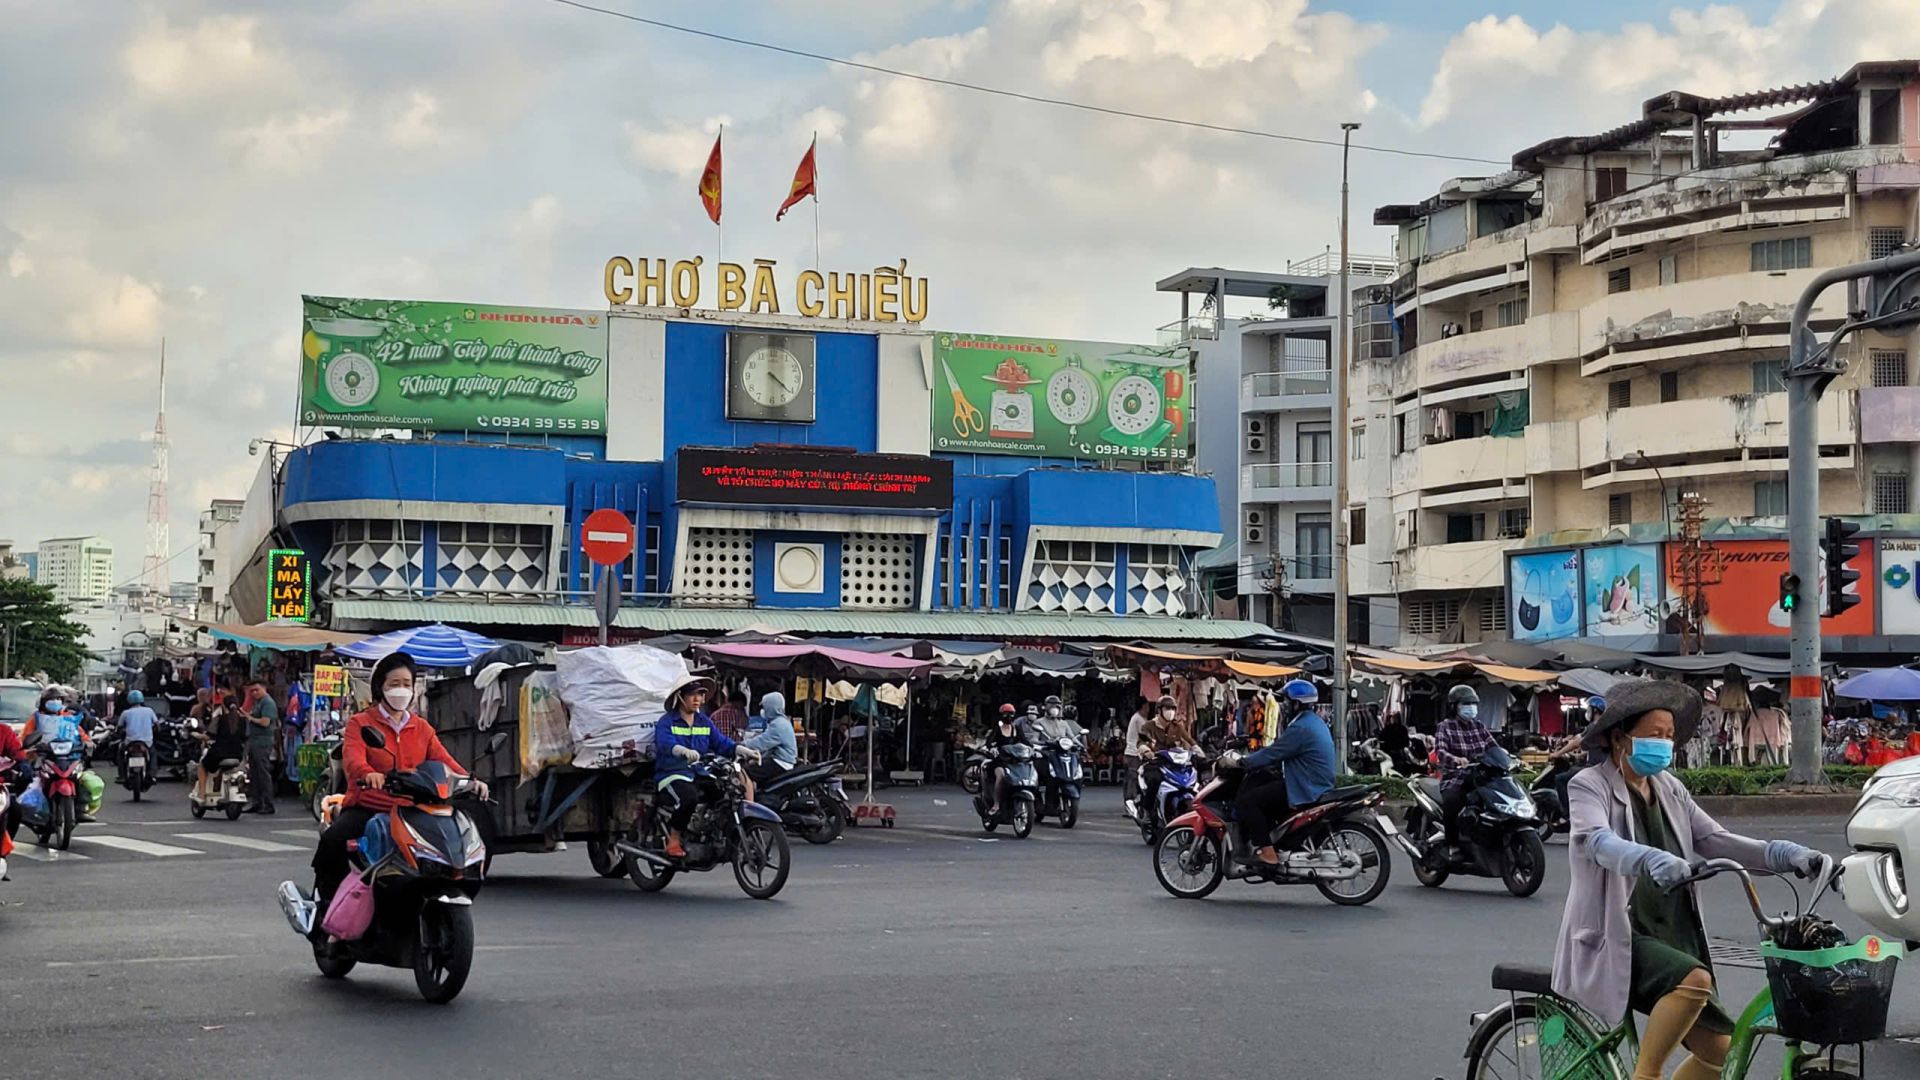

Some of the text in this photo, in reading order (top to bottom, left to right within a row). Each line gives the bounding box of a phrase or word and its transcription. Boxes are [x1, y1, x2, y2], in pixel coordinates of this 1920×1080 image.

[604, 256, 703, 317] CHỢ
[796, 258, 928, 323] CHIỂU
[376, 339, 600, 374] 42 năm Tiếp nối thành công
[399, 374, 577, 400] Không ngừng phát triển
[318, 413, 434, 424] www.nhonhoascale.com.vn
[491, 416, 600, 429] 0934 39 55 39
[949, 438, 1046, 451] www.nhonhoascale.com.vn
[1095, 445, 1187, 458] 0934 39 55 39
[282, 555, 297, 567] XI
[277, 570, 301, 585] MẠ
[274, 584, 303, 600] LẤY
